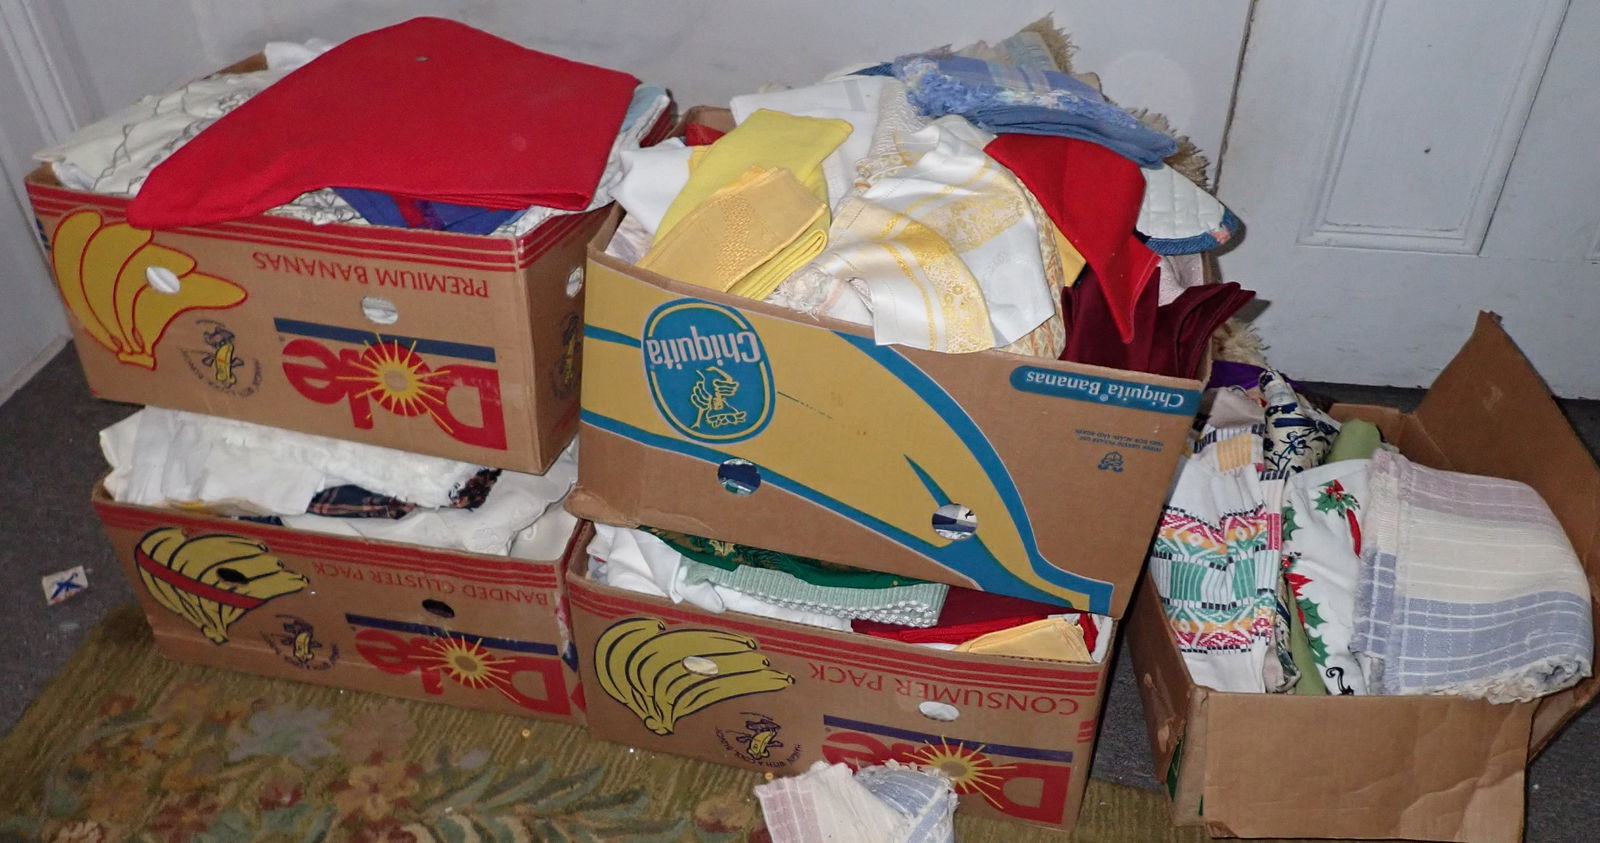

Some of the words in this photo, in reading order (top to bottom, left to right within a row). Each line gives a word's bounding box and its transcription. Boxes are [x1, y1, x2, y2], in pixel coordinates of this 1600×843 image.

[250, 251, 368, 284] BANANAS
[374, 267, 490, 298] PREMIUM
[645, 322, 761, 370] Chiquita
[281, 338, 508, 451] Dole
[1025, 371, 1101, 397] Bananas
[311, 560, 364, 582] PACK
[372, 568, 456, 594] CLUSTER
[462, 583, 549, 607] BANDED
[355, 626, 571, 716] Dole
[808, 662, 883, 692] PACK
[892, 678, 1080, 717] CONSUMER
